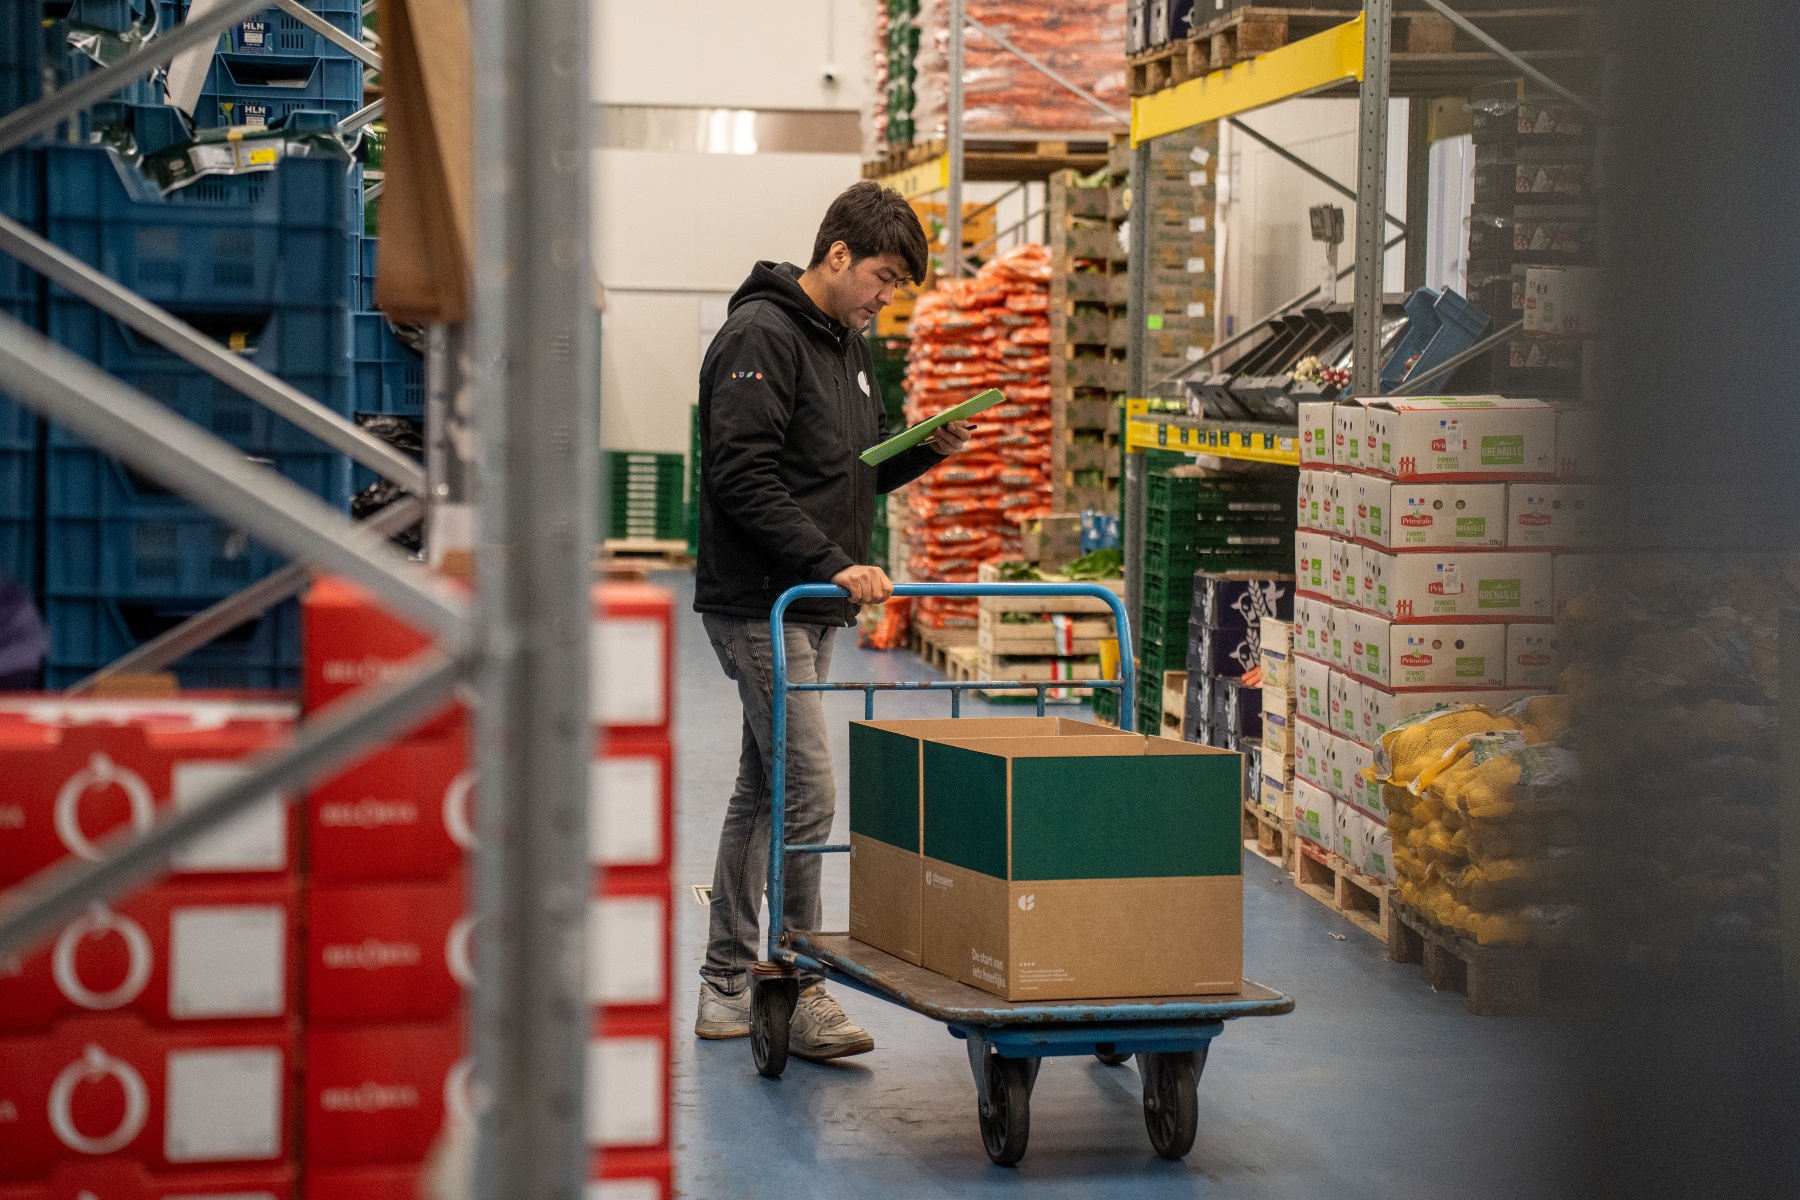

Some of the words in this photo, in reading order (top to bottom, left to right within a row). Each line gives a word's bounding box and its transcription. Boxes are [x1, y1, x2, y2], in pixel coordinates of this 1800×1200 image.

[243, 22, 264, 30] HLN
[245, 106, 266, 114] HLN
[1482, 446, 1523, 457] GRENAILLE
[1402, 517, 1432, 526] Priméale
[1489, 539, 1503, 547] 10kg
[1479, 590, 1520, 600] GRENAILLE
[1401, 657, 1432, 665] Priméale
[972, 948, 980, 962] De
